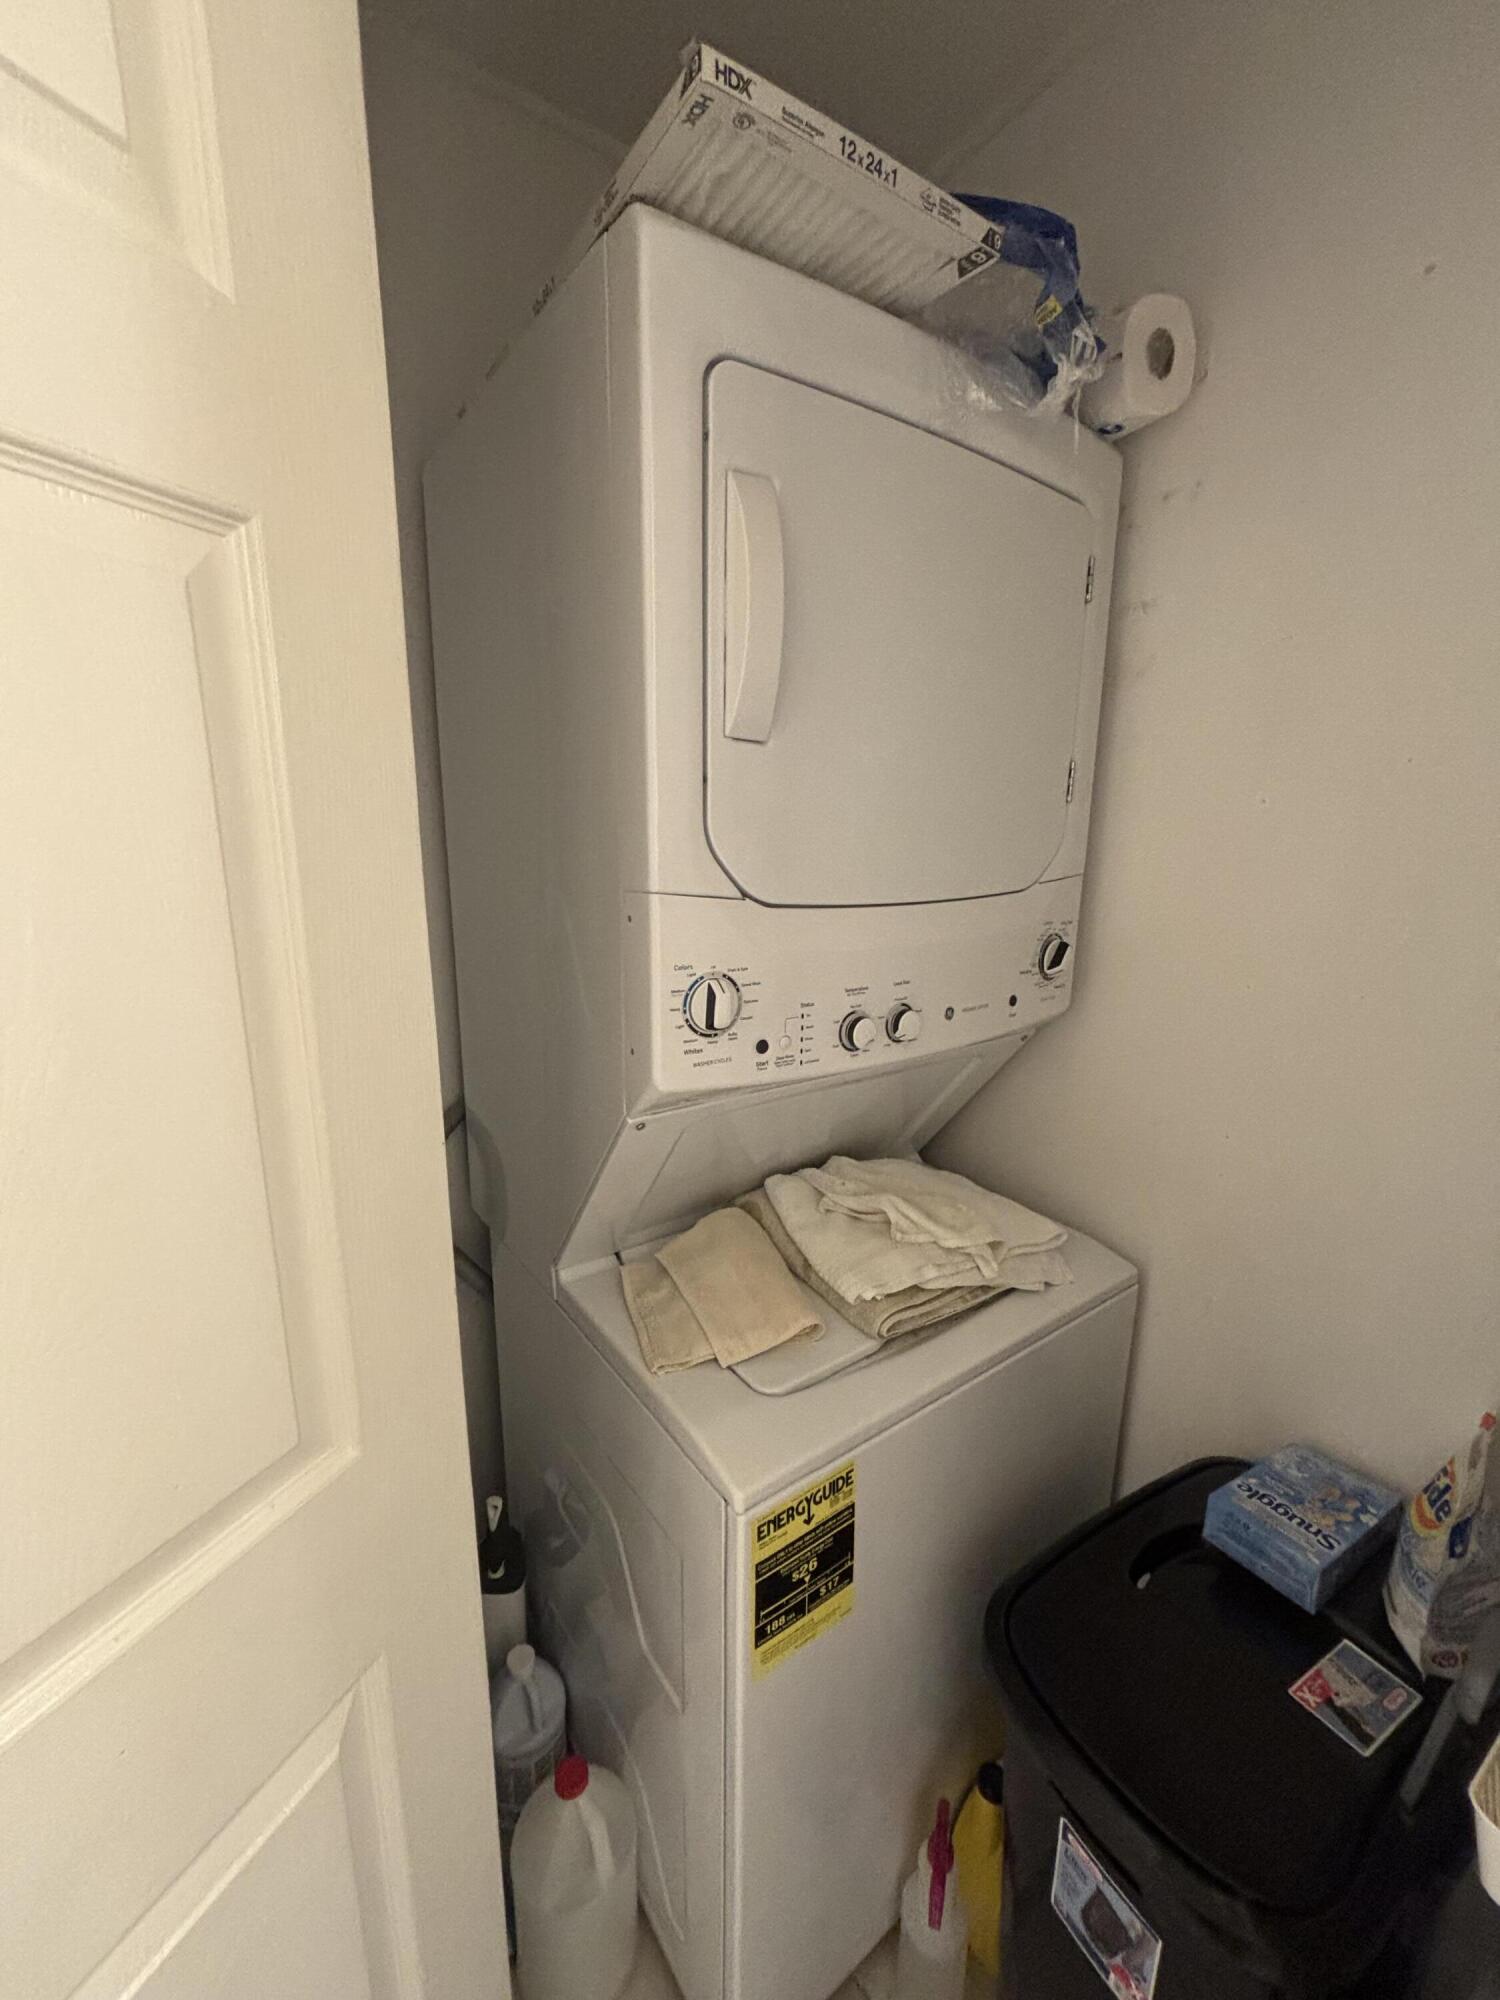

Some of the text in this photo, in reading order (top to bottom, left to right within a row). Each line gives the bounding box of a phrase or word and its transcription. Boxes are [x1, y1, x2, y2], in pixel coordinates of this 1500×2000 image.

[715, 58, 753, 100] HDX
[682, 94, 715, 127] HDX
[673, 964, 693, 972] Colors
[683, 1048, 704, 1056] Whites
[756, 1468, 855, 1543] ENERGYGUIDE
[1422, 1465, 1452, 1523] ide
[1236, 1479, 1342, 1553] Snuggle
[791, 1556, 819, 1583] $26
